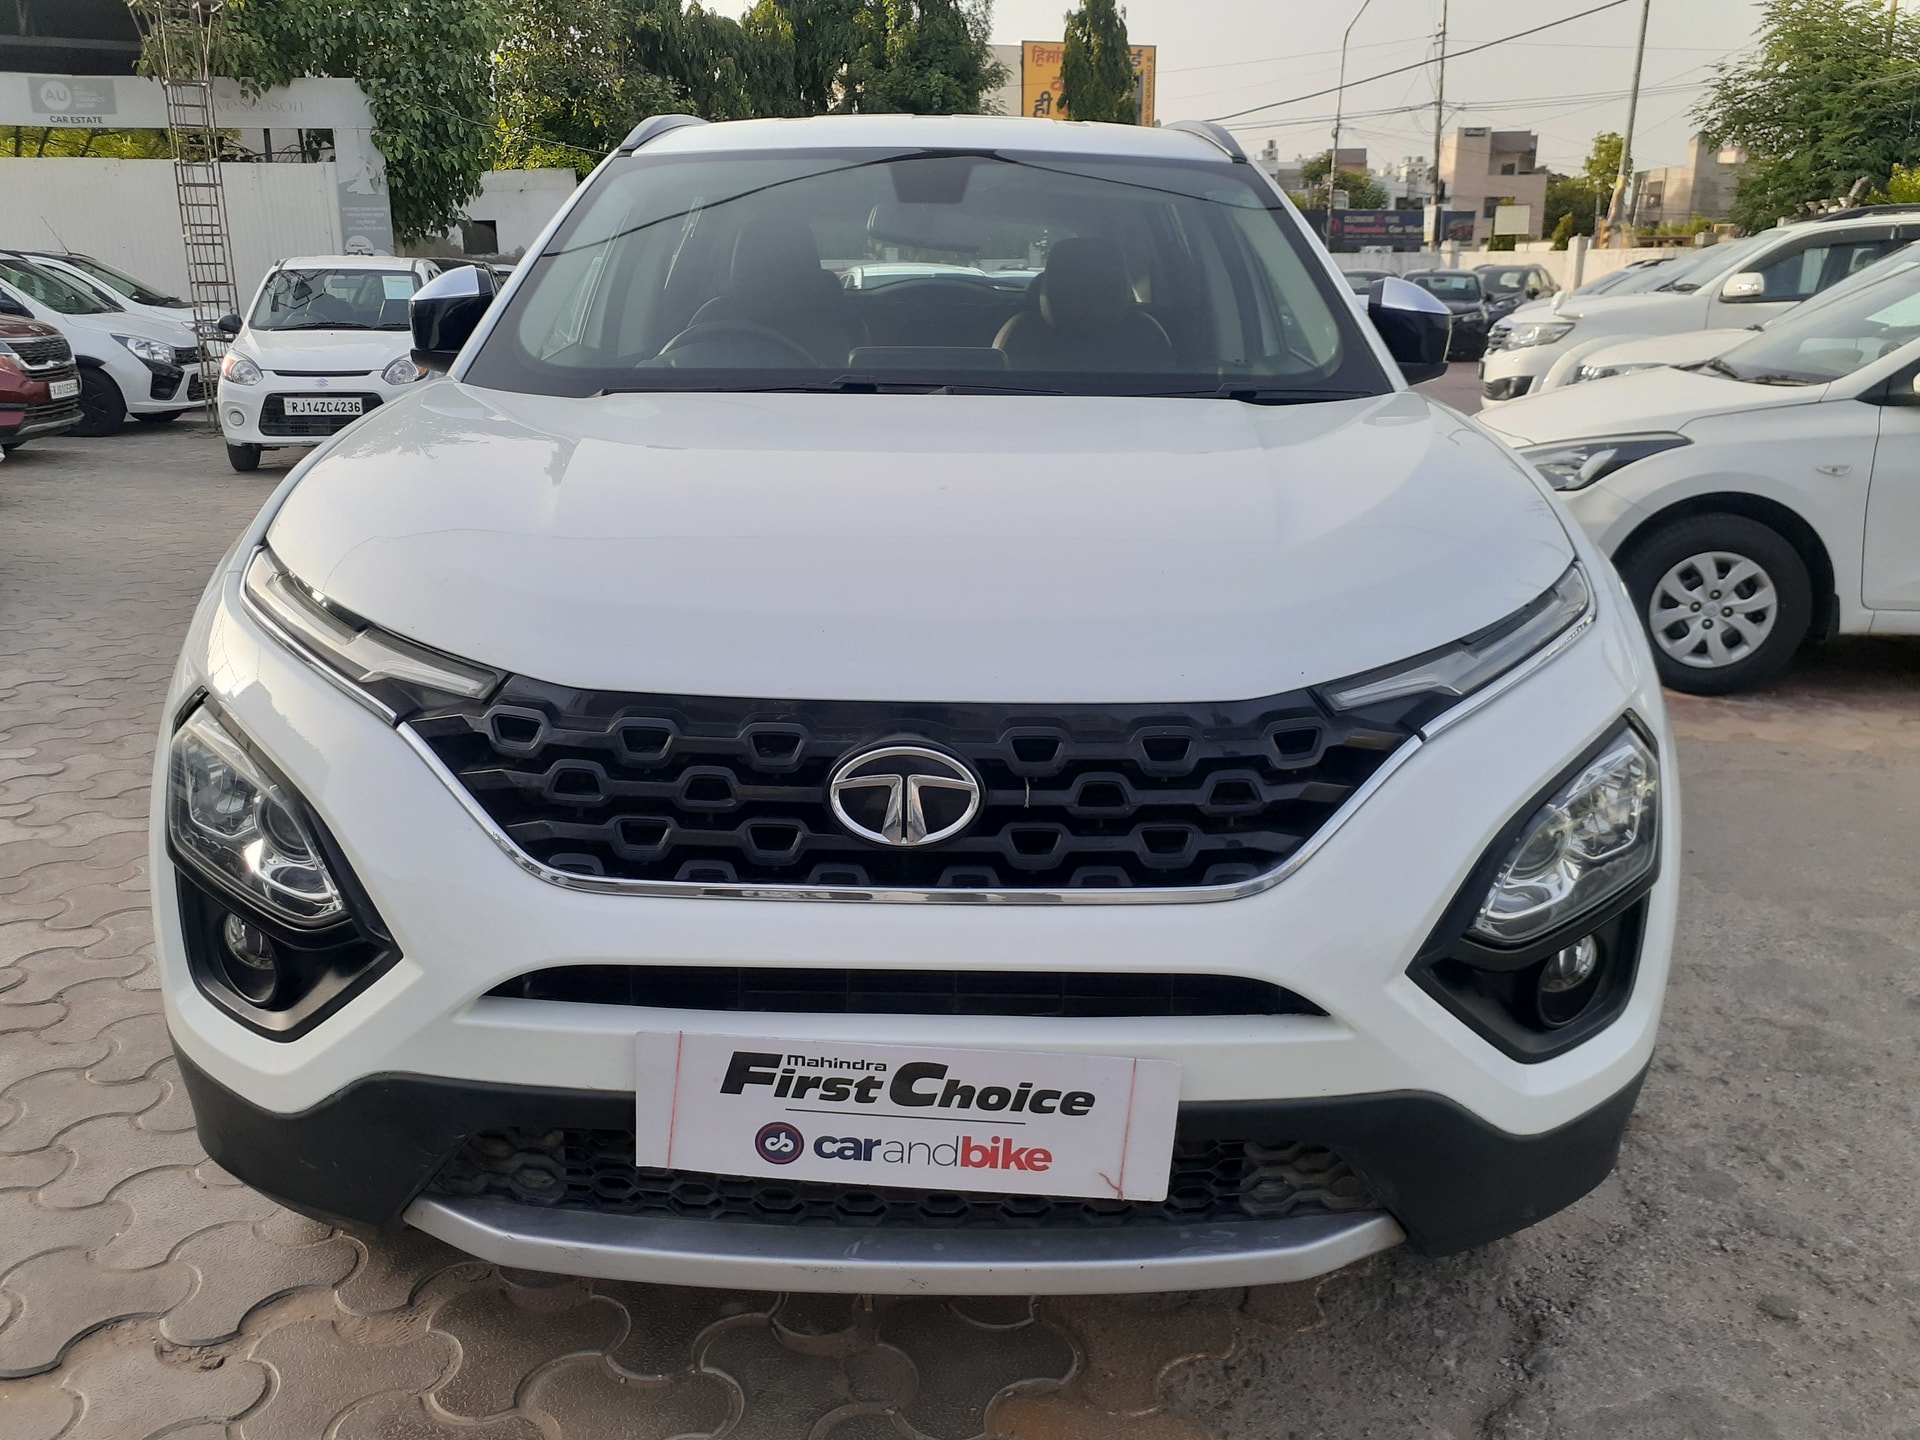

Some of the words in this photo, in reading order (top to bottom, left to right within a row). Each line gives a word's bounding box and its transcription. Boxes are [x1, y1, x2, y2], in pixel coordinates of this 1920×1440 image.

[49, 115, 69, 123] CAR
[70, 116, 103, 124] ESTATE
[291, 401, 361, 413] RJ14ZC4236
[786, 1054, 887, 1072] Mahindra
[719, 1050, 885, 1104] First
[889, 1061, 1096, 1117] Choice
[813, 1135, 1053, 1172] carandbike
